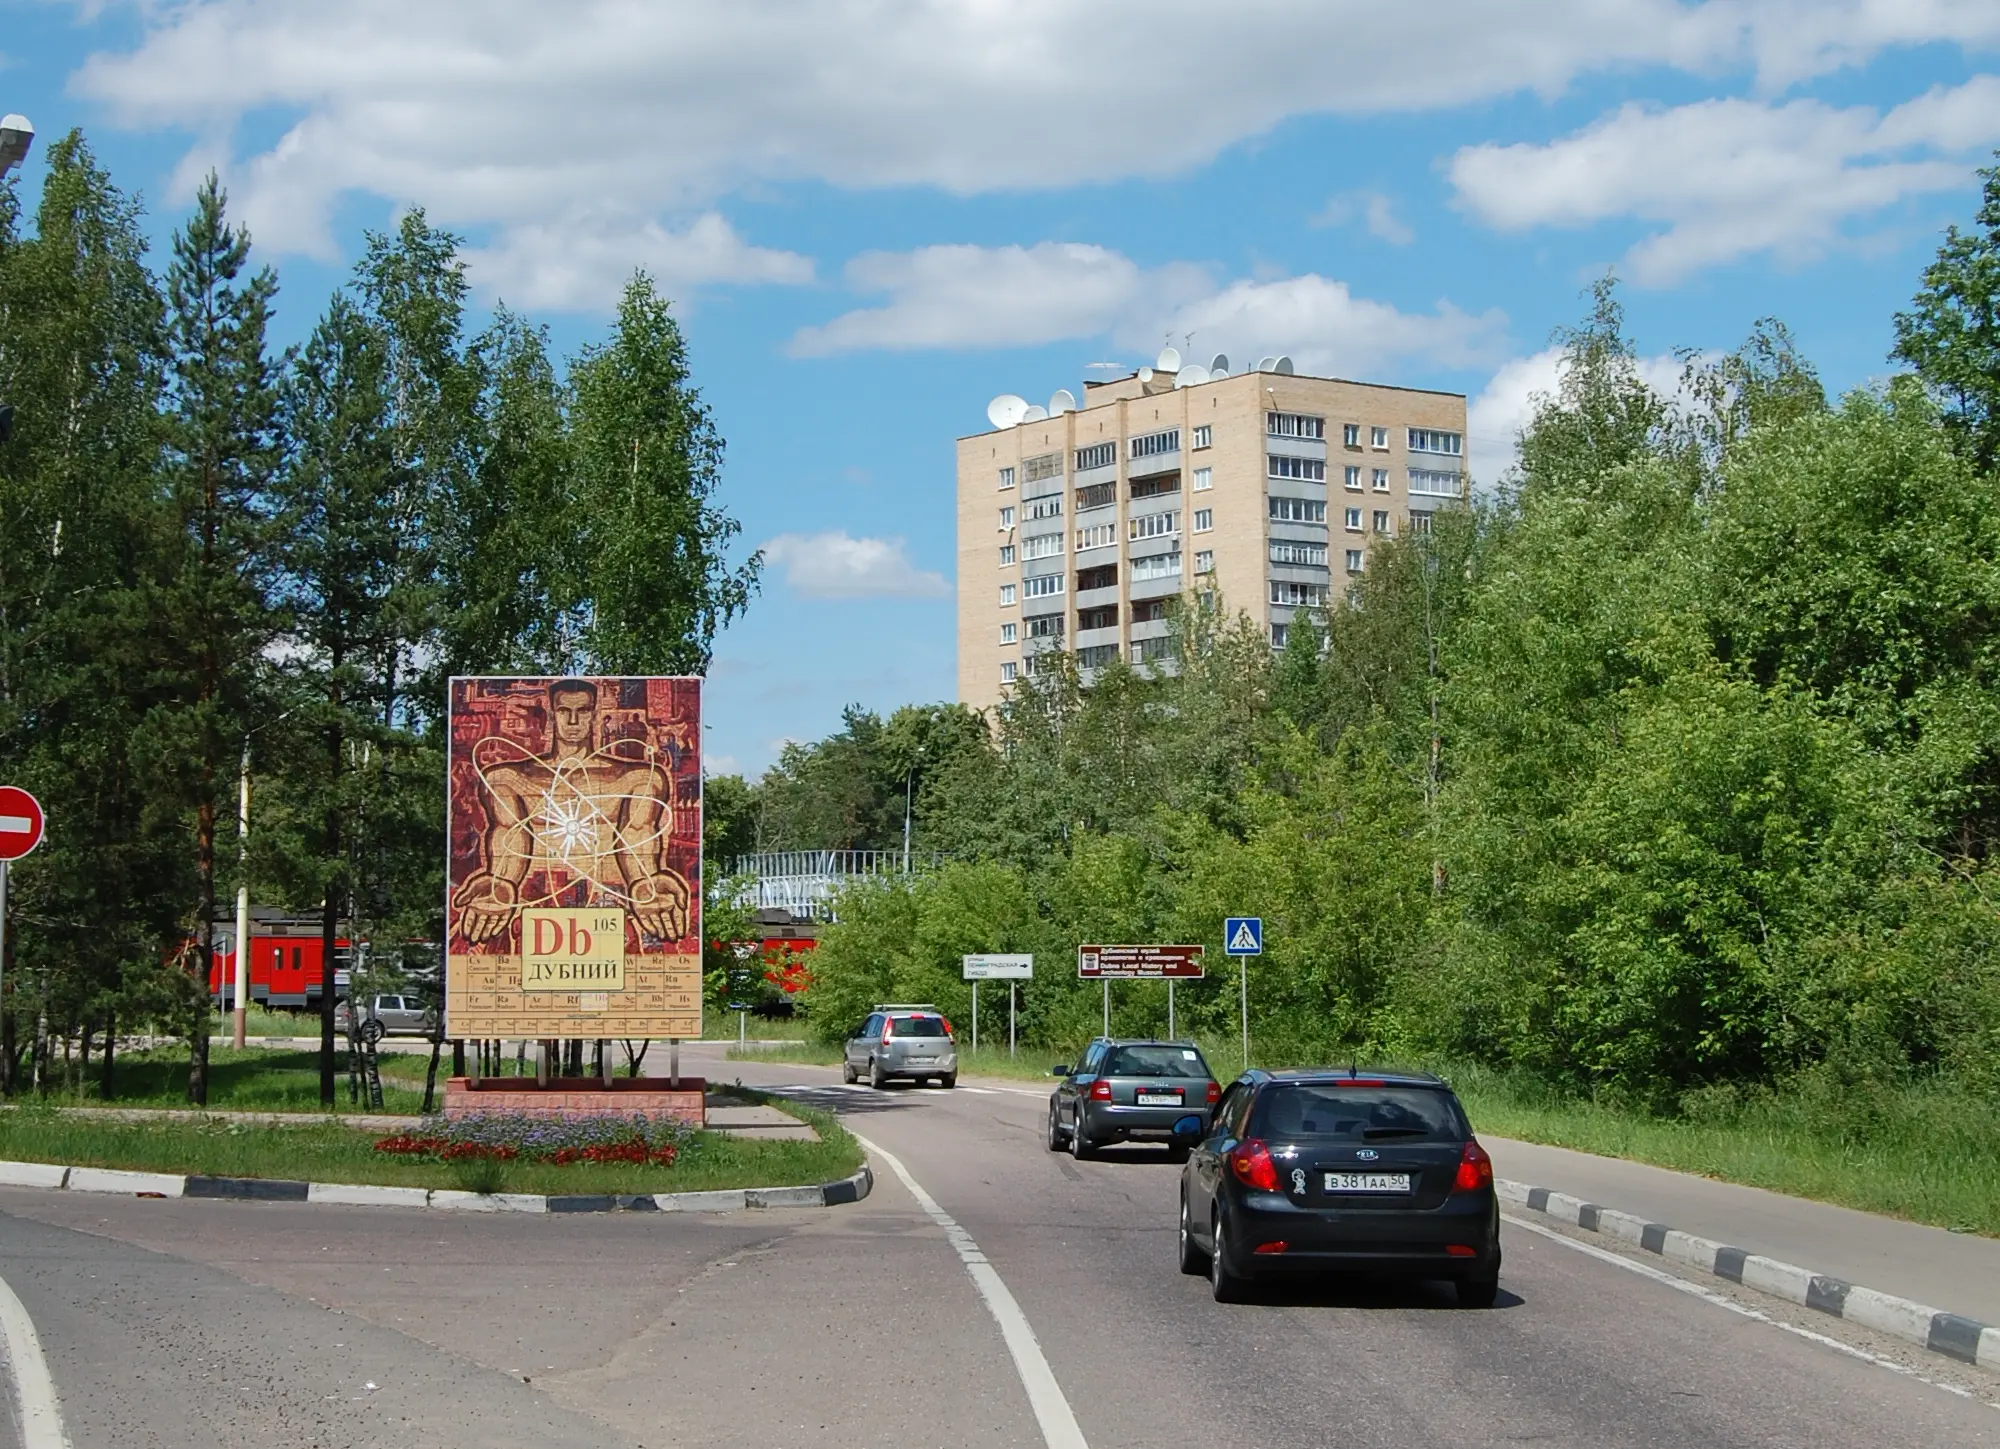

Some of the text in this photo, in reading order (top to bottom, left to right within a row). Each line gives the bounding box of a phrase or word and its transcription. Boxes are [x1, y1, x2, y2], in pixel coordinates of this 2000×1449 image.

[593, 918, 617, 931] 105
[529, 917, 592, 956] Db
[528, 960, 617, 982] ДУБНИЙ
[1390, 1174, 1405, 1185] 50
